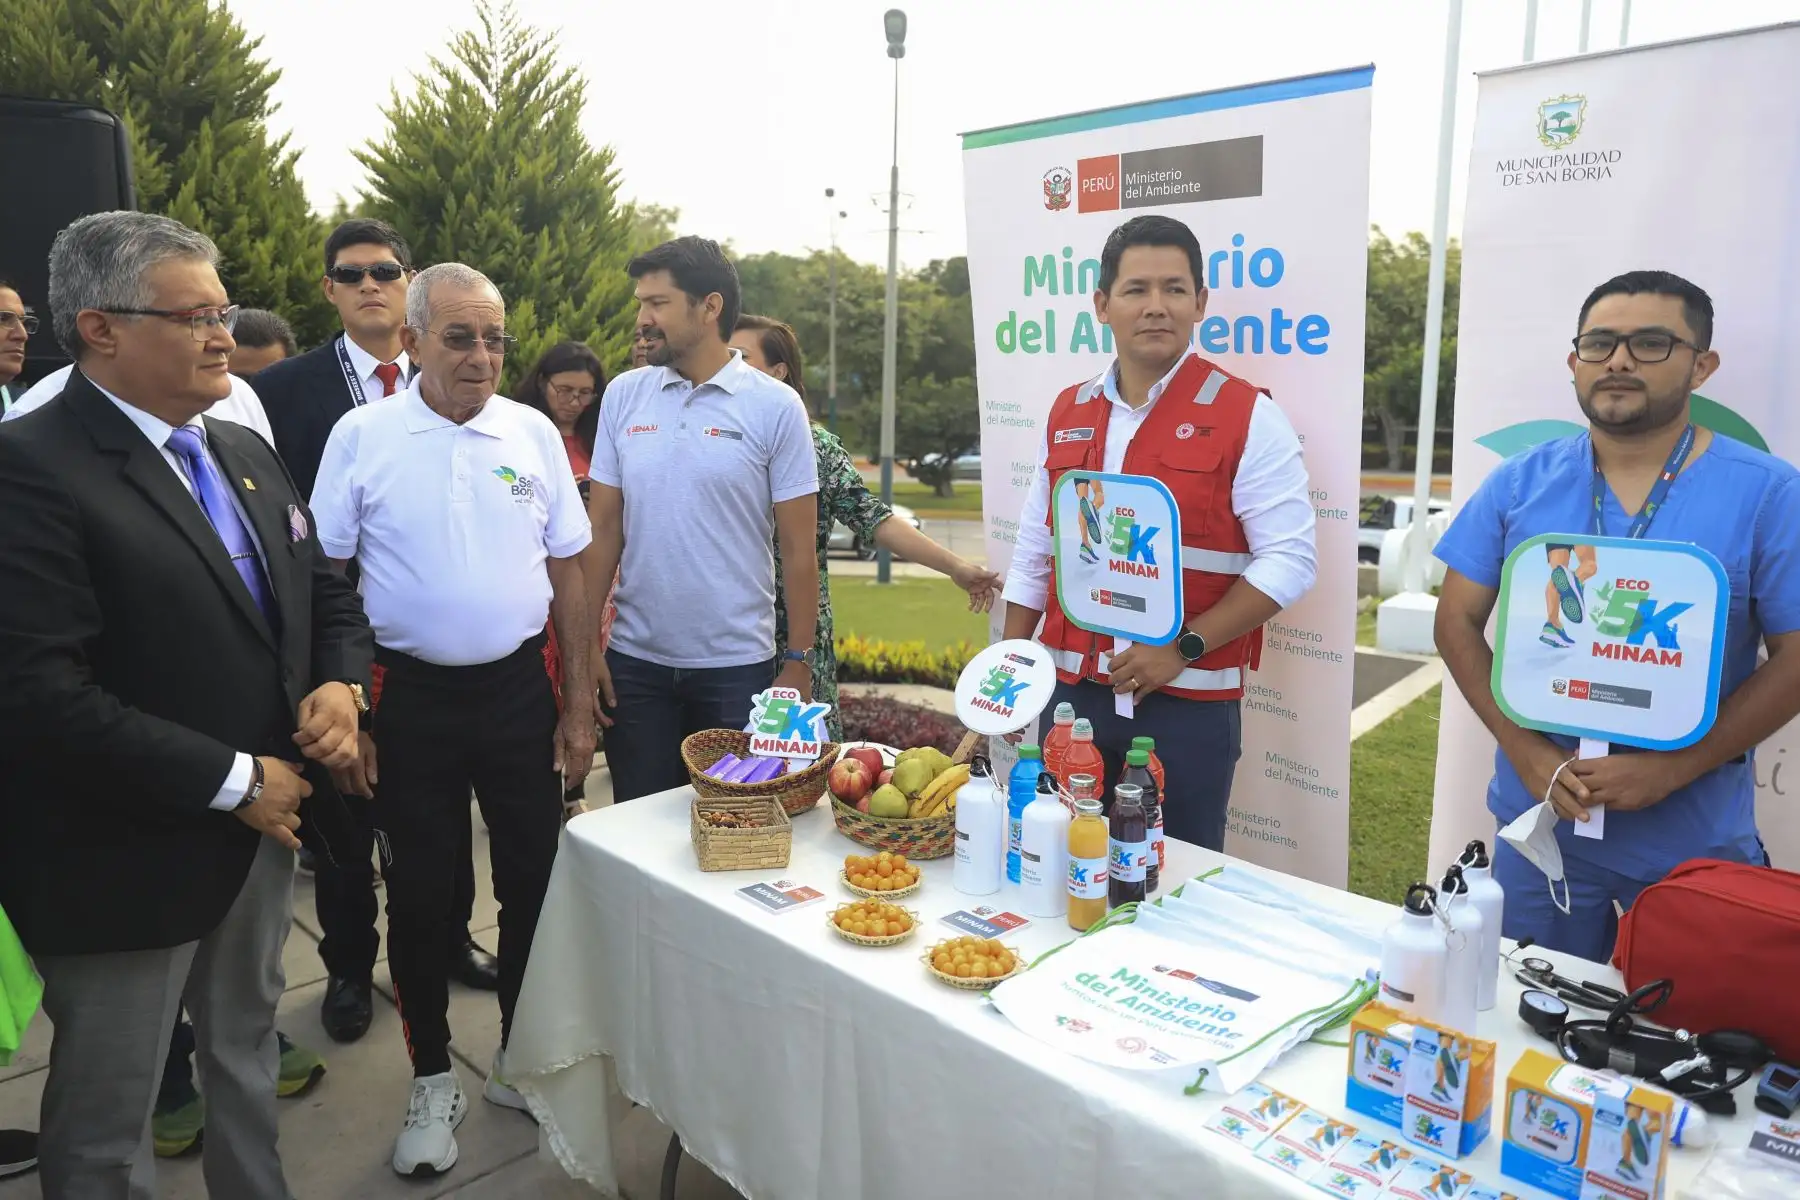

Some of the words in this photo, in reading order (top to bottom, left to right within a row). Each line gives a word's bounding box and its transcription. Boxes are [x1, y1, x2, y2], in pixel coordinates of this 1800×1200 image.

[1496, 149, 1622, 173] MUNICIPALIDAD
[1082, 172, 1115, 193] PERÚ
[1125, 168, 1182, 186] Ministerio
[1503, 173, 1523, 187] DE
[1526, 170, 1557, 185] SAN
[1562, 166, 1612, 182] BORJA
[1125, 185, 1142, 199] del
[1144, 179, 1201, 197] Ambiente
[1023, 233, 1285, 297] Minrio
[995, 309, 1056, 354] del
[1069, 307, 1331, 356] Aente
[985, 400, 1022, 413] Ministerio
[986, 414, 999, 425] del
[1000, 415, 1036, 428] Ambiente
[1115, 506, 1136, 518] ECO
[1110, 516, 1161, 566] 5K
[1109, 558, 1160, 580] MINAM
[1615, 578, 1650, 592] ECO
[1595, 589, 1696, 650] 5K
[1267, 620, 1323, 643] Ministerio
[1267, 635, 1282, 651] del
[1284, 639, 1343, 664] Ambiente
[1591, 641, 1683, 668] MINAM
[999, 664, 1017, 674] ECO
[772, 690, 797, 699] ECO
[979, 670, 1031, 709] 5K
[970, 696, 1014, 719] MINAM
[1245, 698, 1298, 722] Ambiente
[756, 698, 827, 742] 5K
[753, 738, 818, 755] MINAM
[1265, 750, 1320, 778] Ministerio
[1264, 767, 1282, 781] del
[1284, 772, 1340, 799] Ambiente
[1241, 825, 1298, 850] Ambiente
[752, 886, 789, 905] MINAM
[954, 915, 996, 934] MINAM
[1075, 972, 1120, 998] del
[1114, 995, 1245, 1040] Ambiente
[1109, 966, 1238, 1023] Ministerio
